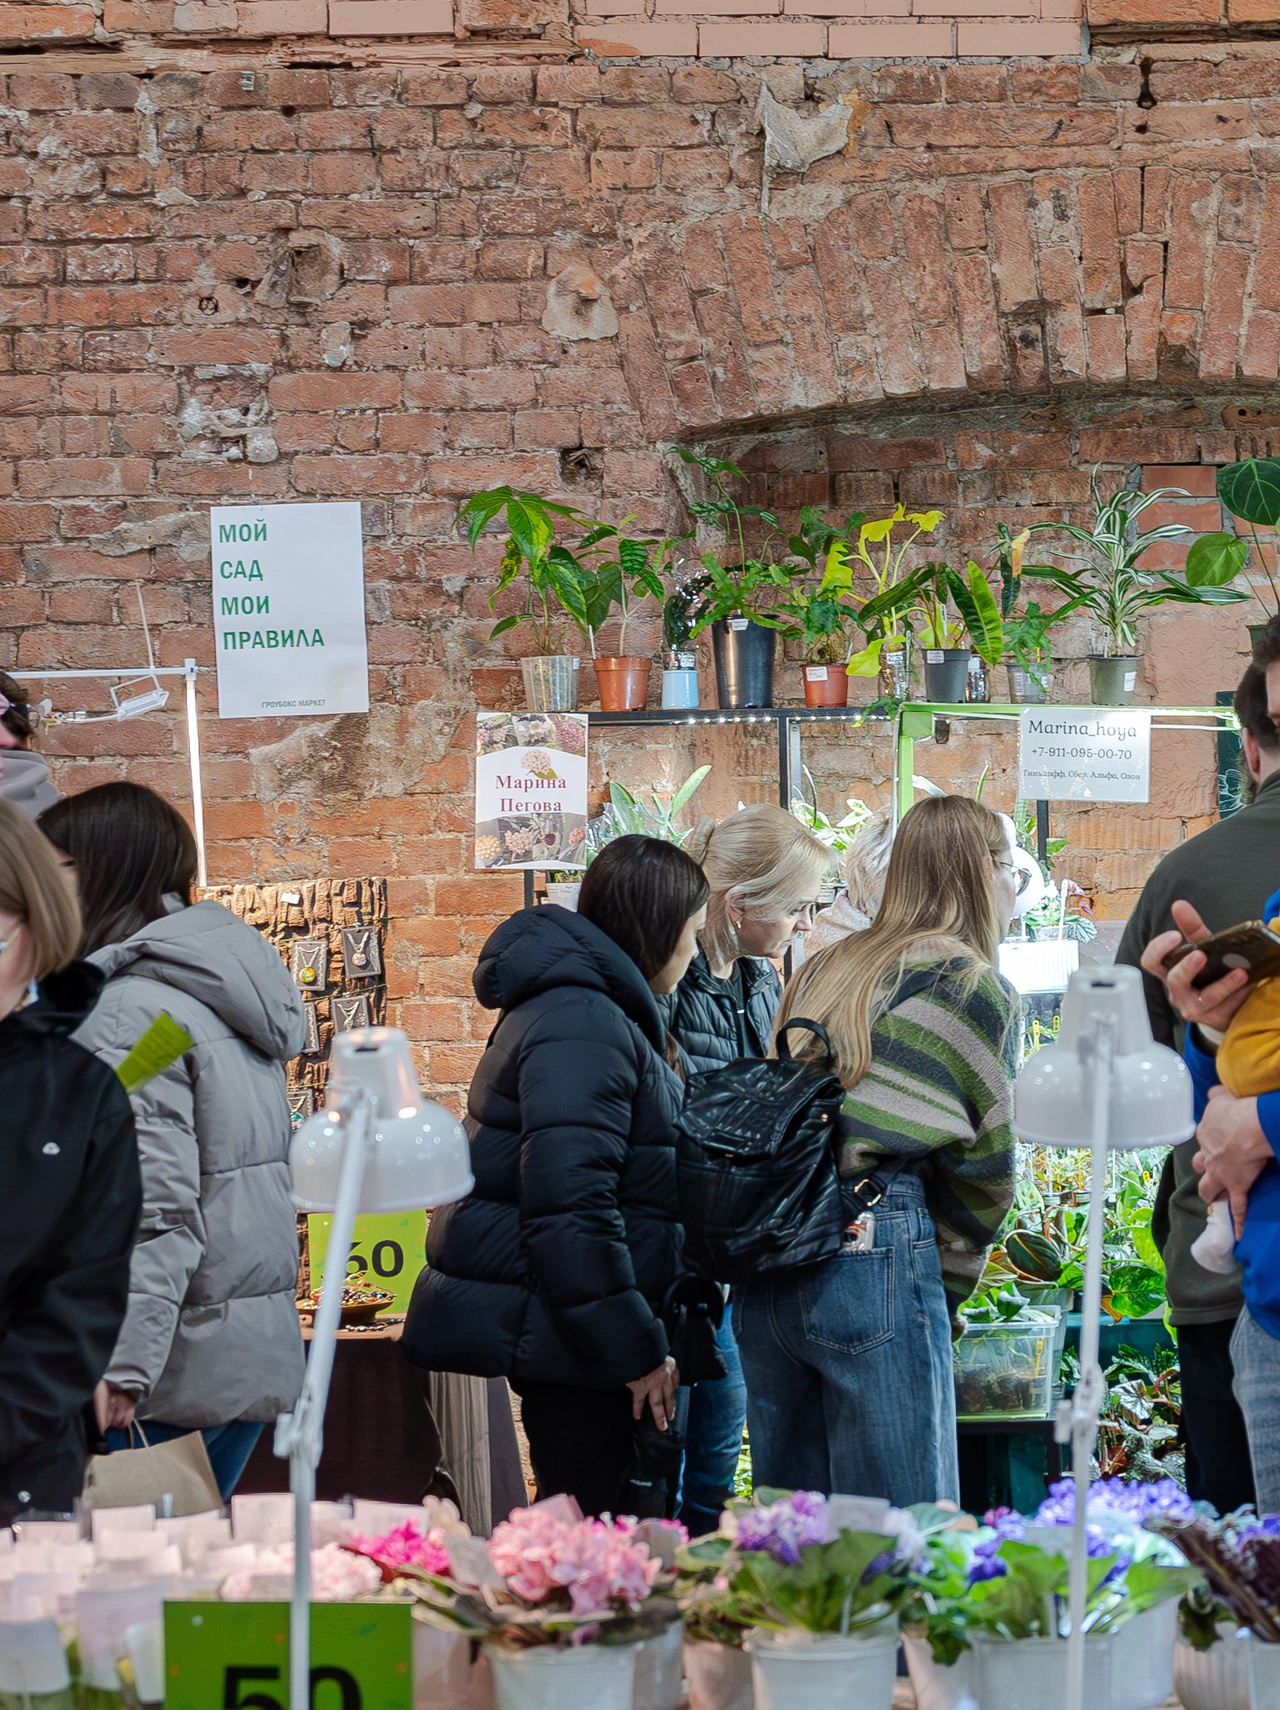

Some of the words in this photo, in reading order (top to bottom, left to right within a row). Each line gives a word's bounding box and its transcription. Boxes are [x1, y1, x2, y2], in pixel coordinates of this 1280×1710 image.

[219, 518, 267, 543] МОЙ
[220, 559, 263, 582] САД
[221, 595, 270, 615] МОИ
[223, 628, 325, 650] ПРАВИЛА
[261, 700, 297, 709] ГРОУБОКС
[298, 699, 326, 707] МАРКЕТ
[1028, 720, 1137, 741] Marina_hoya
[1031, 746, 1132, 760] +7-911-095-00-70
[495, 774, 567, 793] Марина
[500, 798, 562, 812] Пегова
